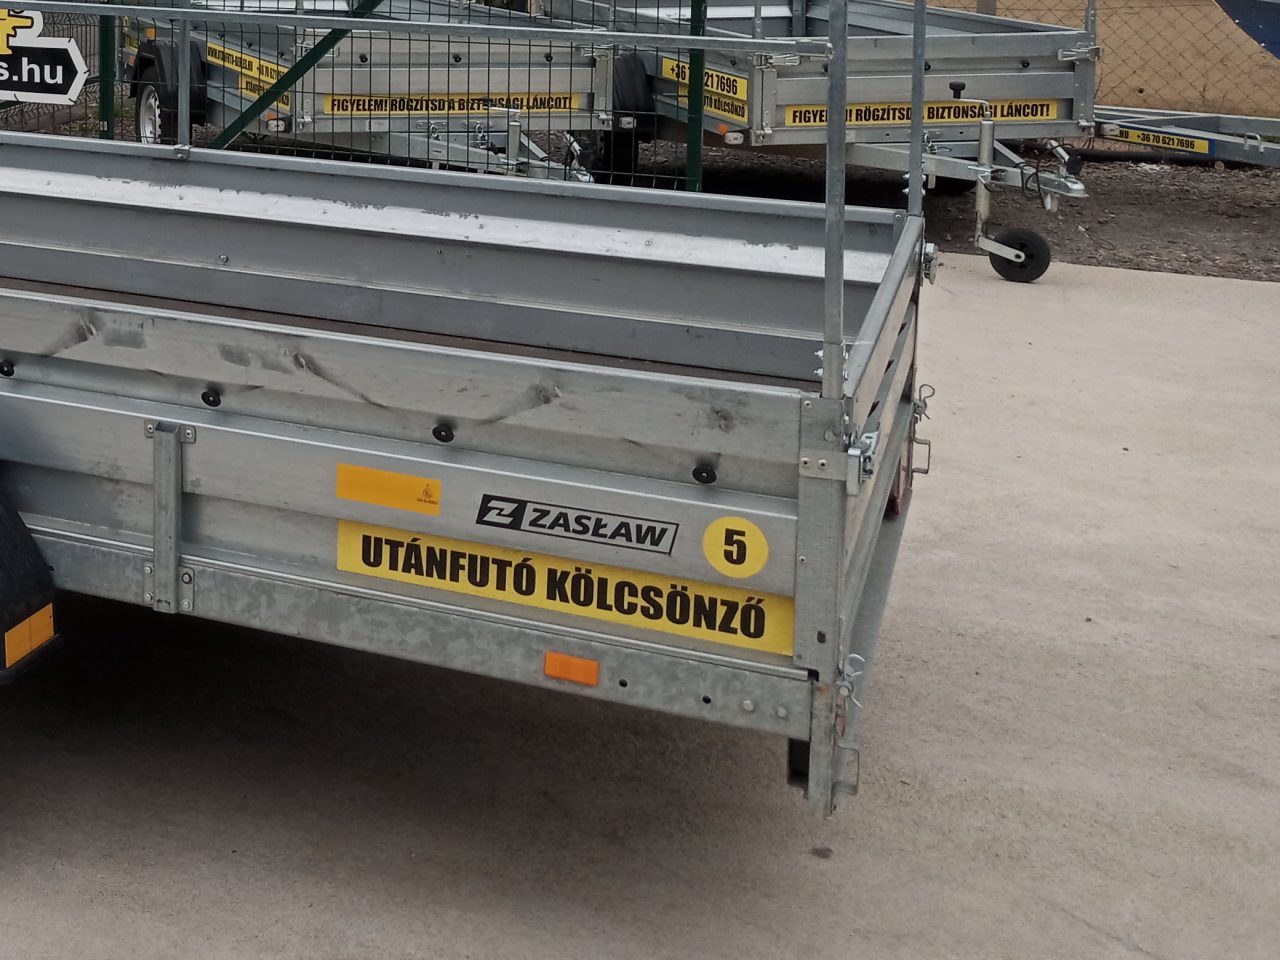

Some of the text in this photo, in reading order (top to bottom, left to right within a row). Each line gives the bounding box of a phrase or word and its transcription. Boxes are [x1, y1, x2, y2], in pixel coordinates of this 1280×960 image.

[670, 63, 686, 81] +36
[715, 74, 738, 96] 7696
[330, 98, 388, 112] FIGYELEM!
[1000, 102, 1050, 118] LÁNCOT!
[1136, 132, 1151, 143] +36
[1152, 134, 1161, 144] 70
[1161, 136, 1175, 146] 621
[1175, 138, 1196, 150] 7696
[528, 507, 668, 547] ZASŁAW
[723, 527, 748, 566] 5
[361, 534, 766, 640] UTÁNFUTÓ KÖLCSÖNZŐ
